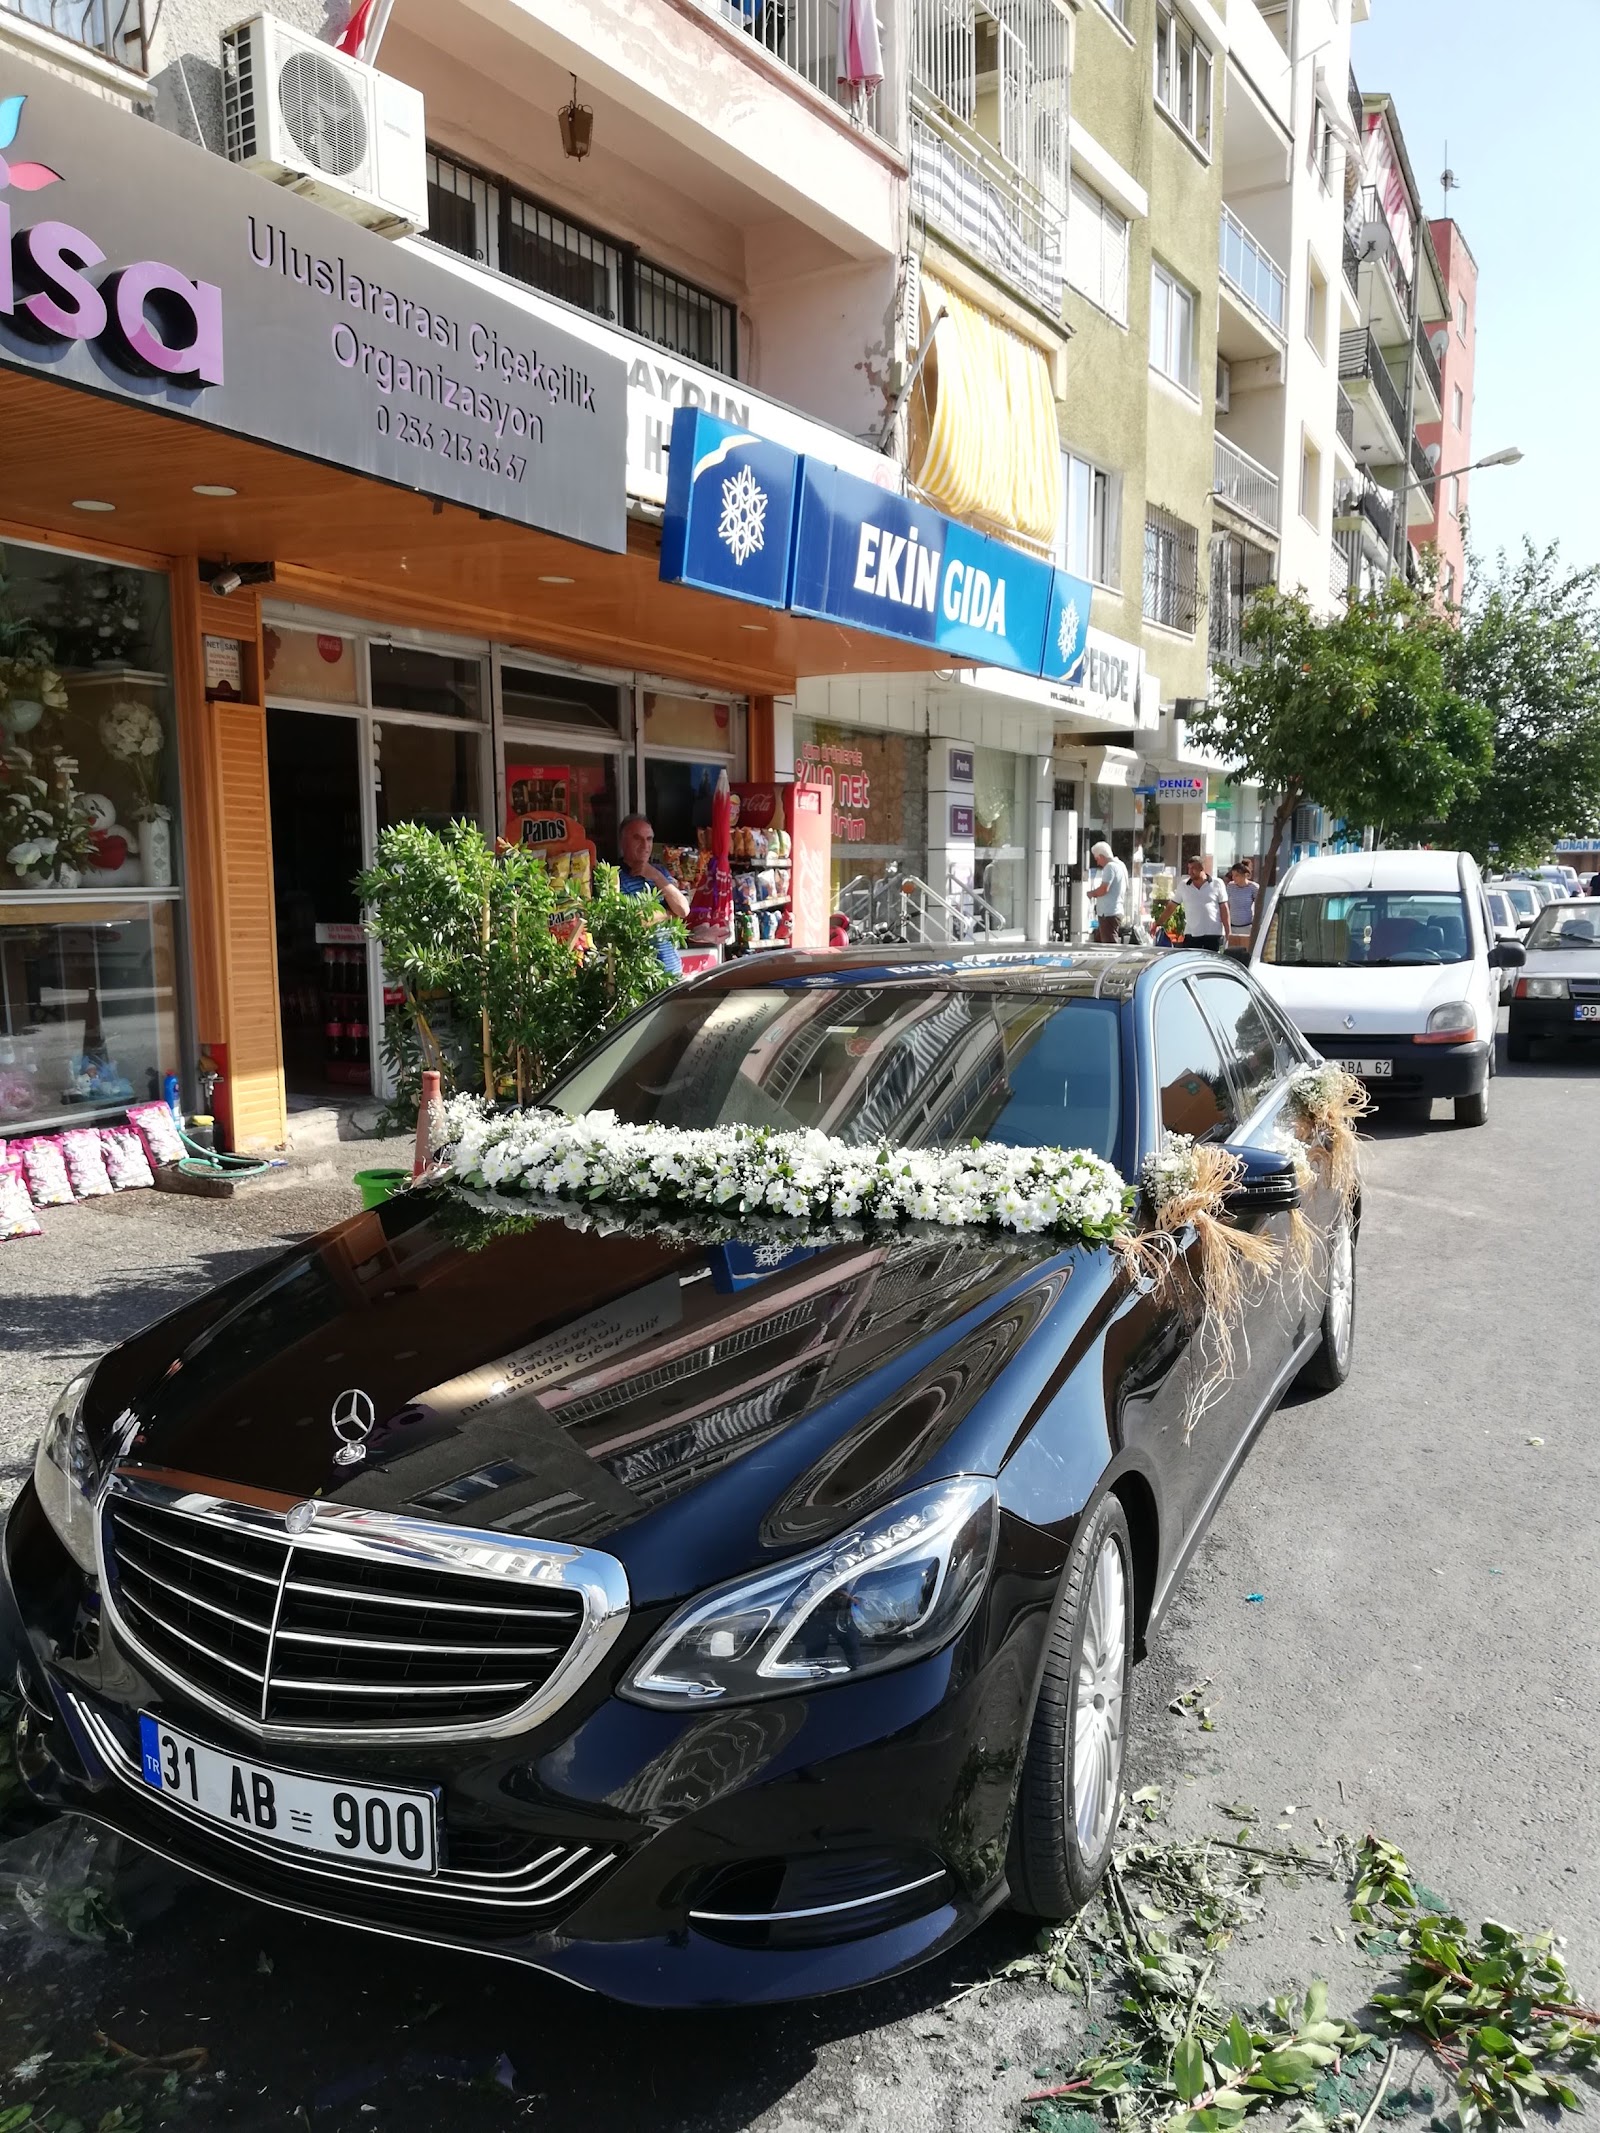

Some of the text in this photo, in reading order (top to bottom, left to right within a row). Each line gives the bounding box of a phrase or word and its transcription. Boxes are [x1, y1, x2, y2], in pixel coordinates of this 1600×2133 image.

[247, 215, 596, 413] Uluslararası Çiçekçilik
[331, 322, 545, 444] Organizasyon
[627, 358, 749, 430] AYDIN
[377, 405, 527, 483] 0 256 213 86 67
[853, 520, 1007, 637] EKİN GIDA
[1159, 777, 1194, 788] DENİZ
[1159, 789, 1204, 798] PETSHOP
[1555, 840, 1590, 851] ADNAN
[1582, 1006, 1597, 1017] 09
[1340, 1061, 1391, 1075] ABA 62
[145, 1753, 161, 1776] TR
[161, 1734, 424, 1861] 31 AB 900
